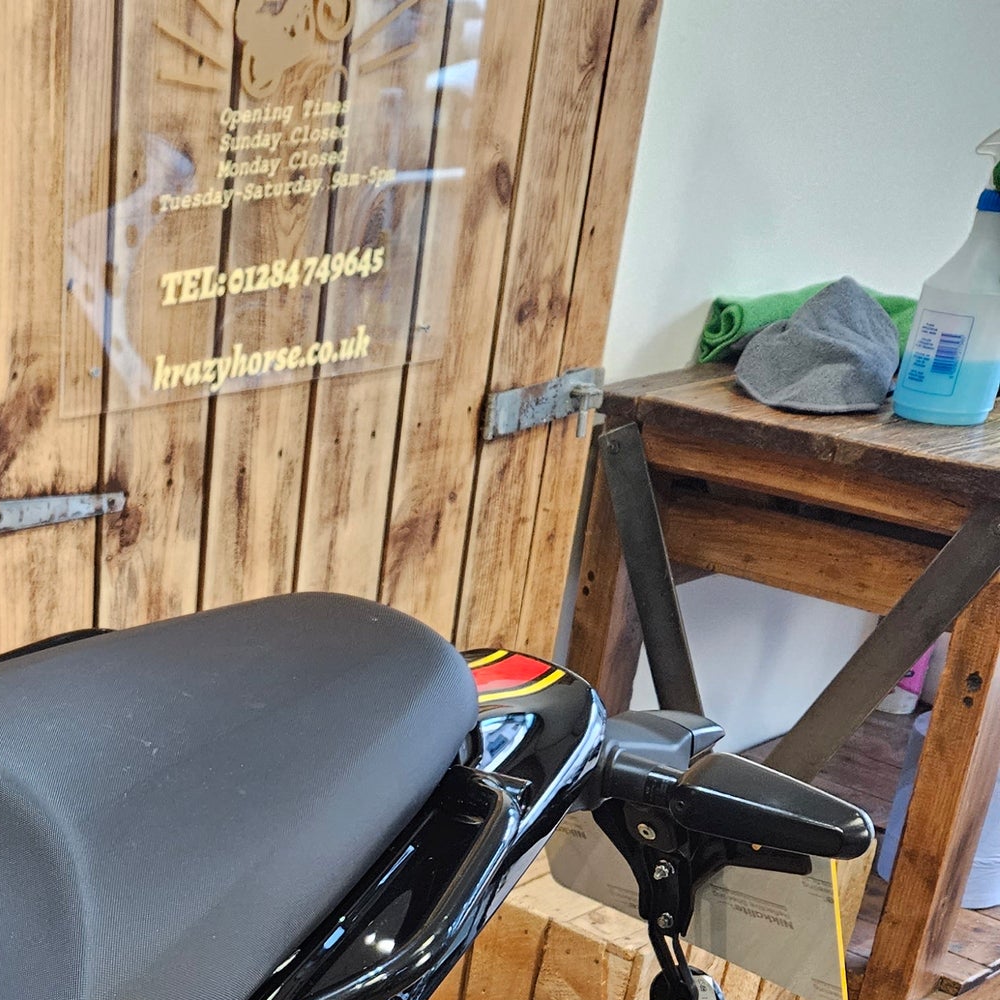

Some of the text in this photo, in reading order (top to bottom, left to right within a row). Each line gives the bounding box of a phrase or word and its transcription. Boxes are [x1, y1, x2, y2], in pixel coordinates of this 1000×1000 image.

[220, 99, 351, 131] Opening Times
[219, 125, 350, 152] Sunday Closed
[216, 146, 348, 178] Monday Closed
[159, 175, 323, 212] Tuesday-Saturday
[153, 324, 371, 392] krazyhorse.co.uk
